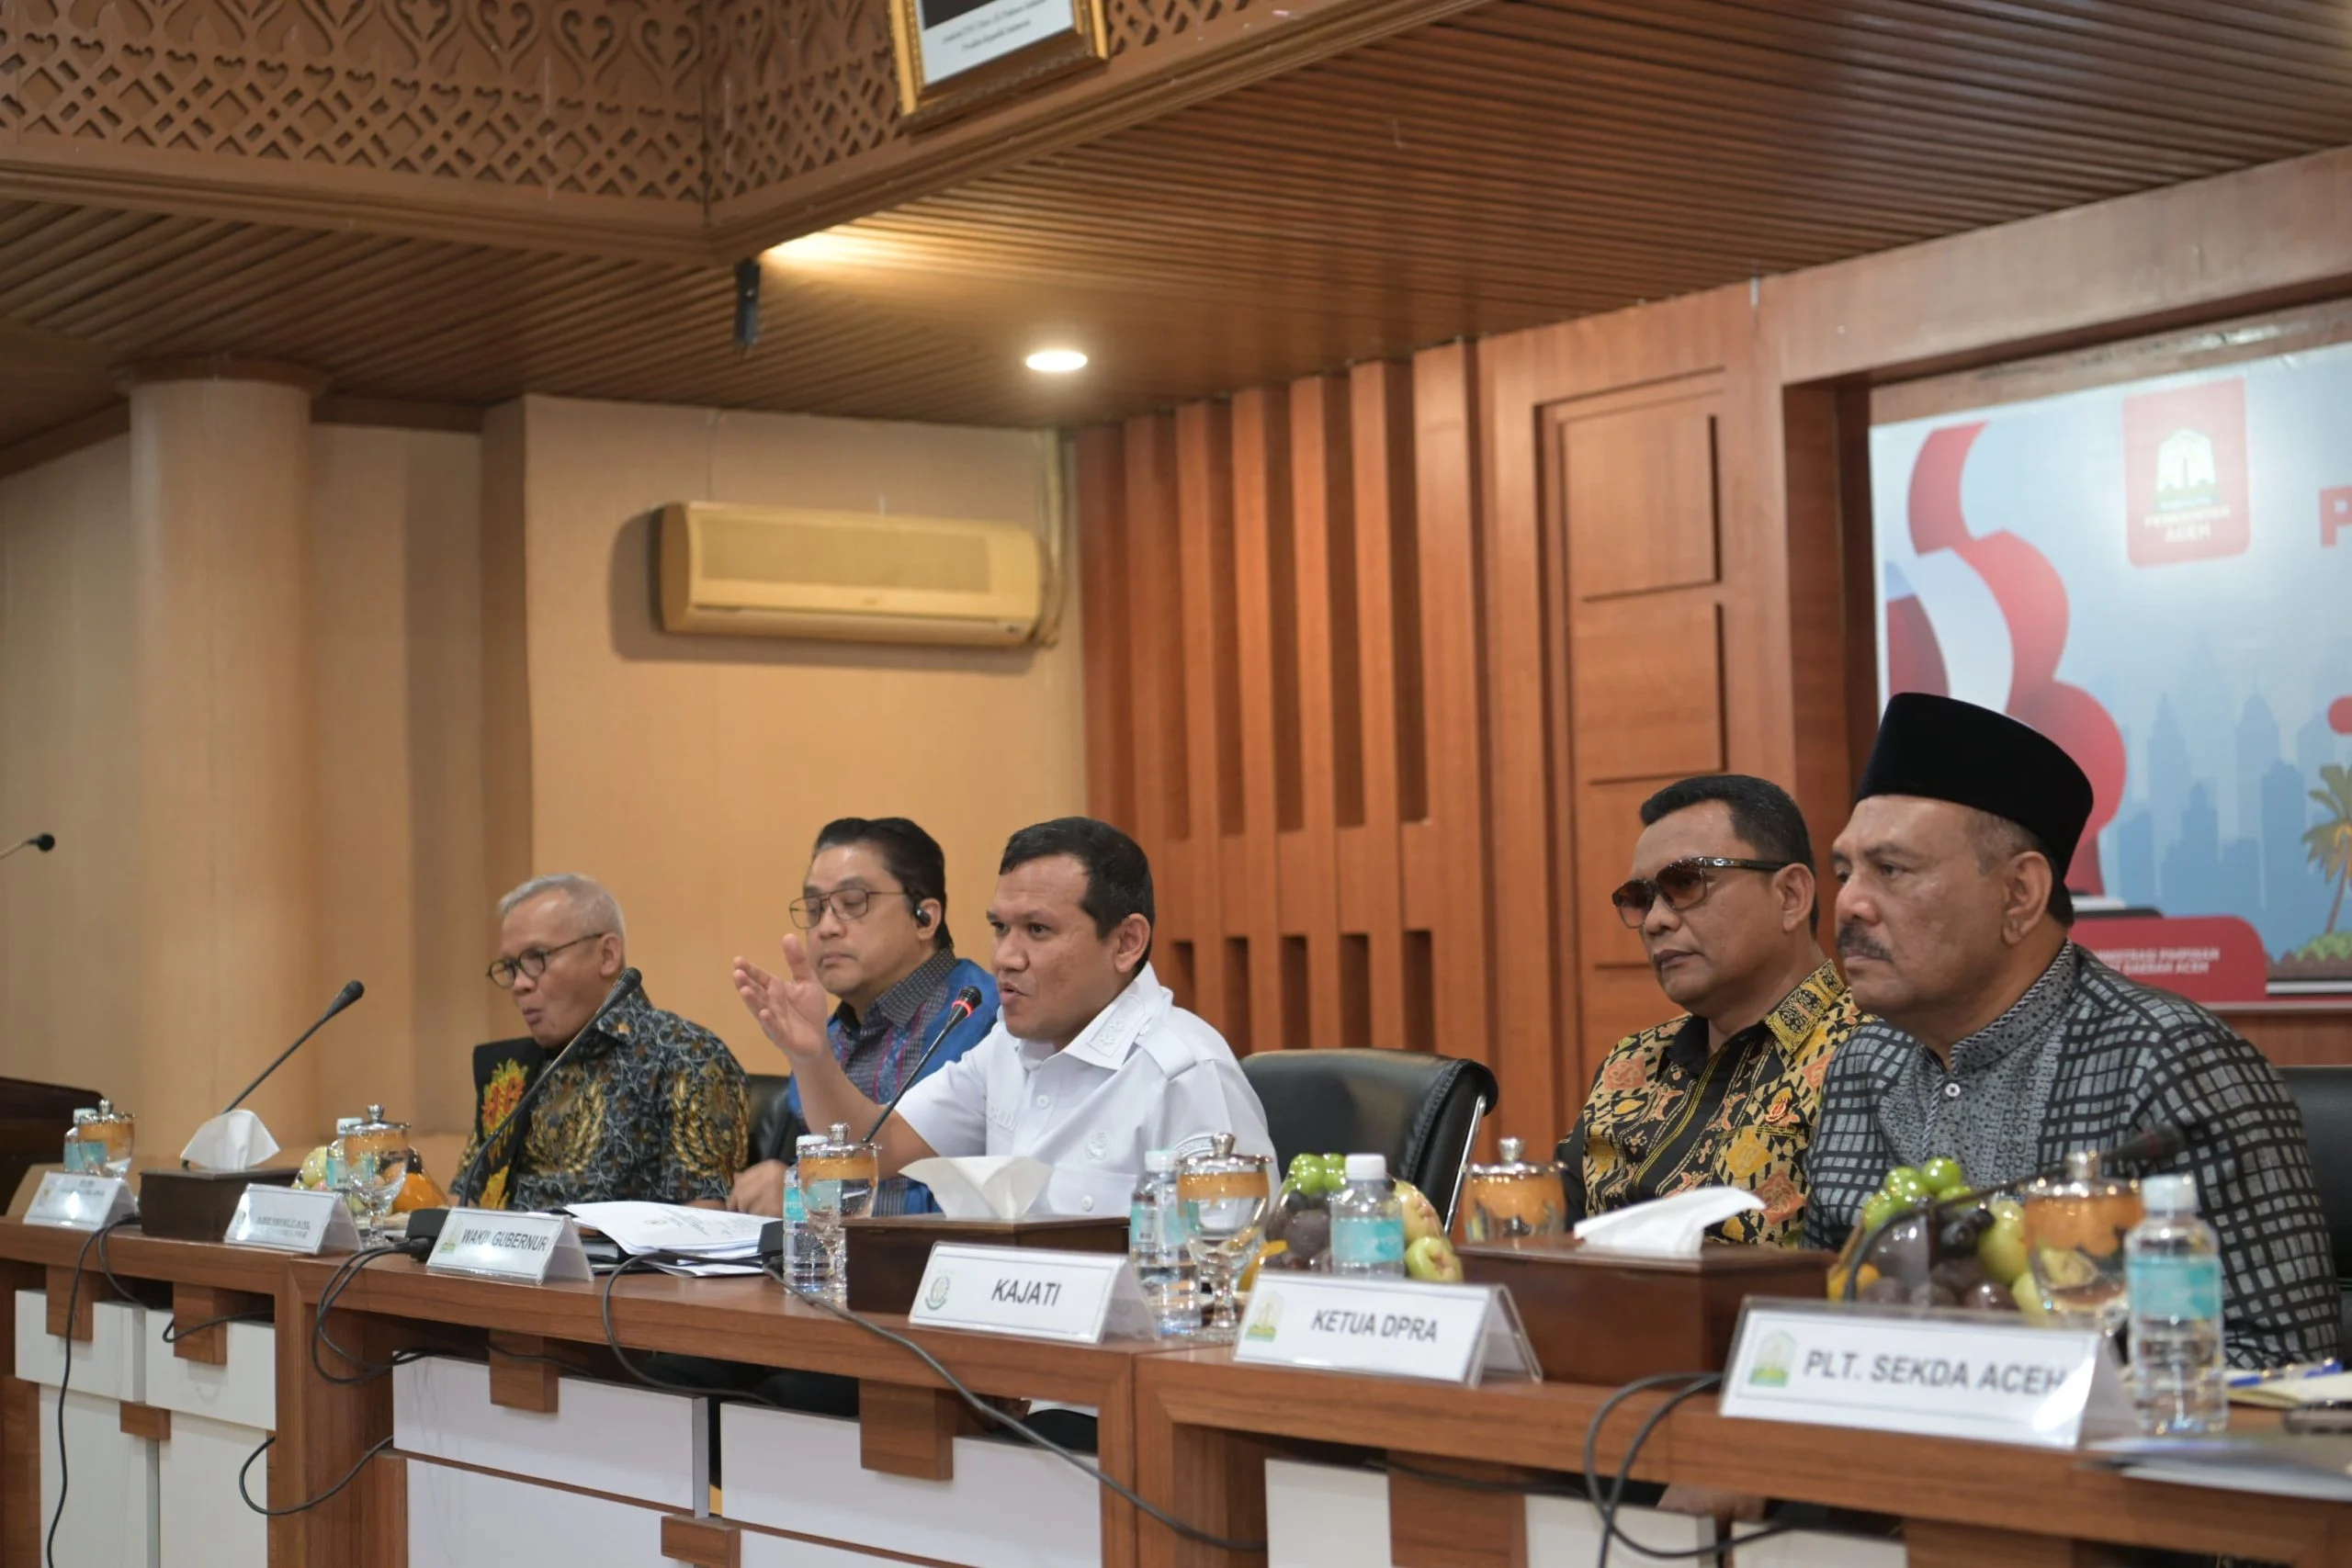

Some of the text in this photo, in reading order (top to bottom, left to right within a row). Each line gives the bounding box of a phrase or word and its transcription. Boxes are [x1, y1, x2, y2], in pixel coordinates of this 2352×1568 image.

[492, 1231, 549, 1252] GUBERNUR
[990, 1278, 1062, 1307] KAJATI
[1311, 1309, 1438, 1344] KETUA DPRA
[1803, 1348, 2069, 1395] PLT. SEKDA ACEH
